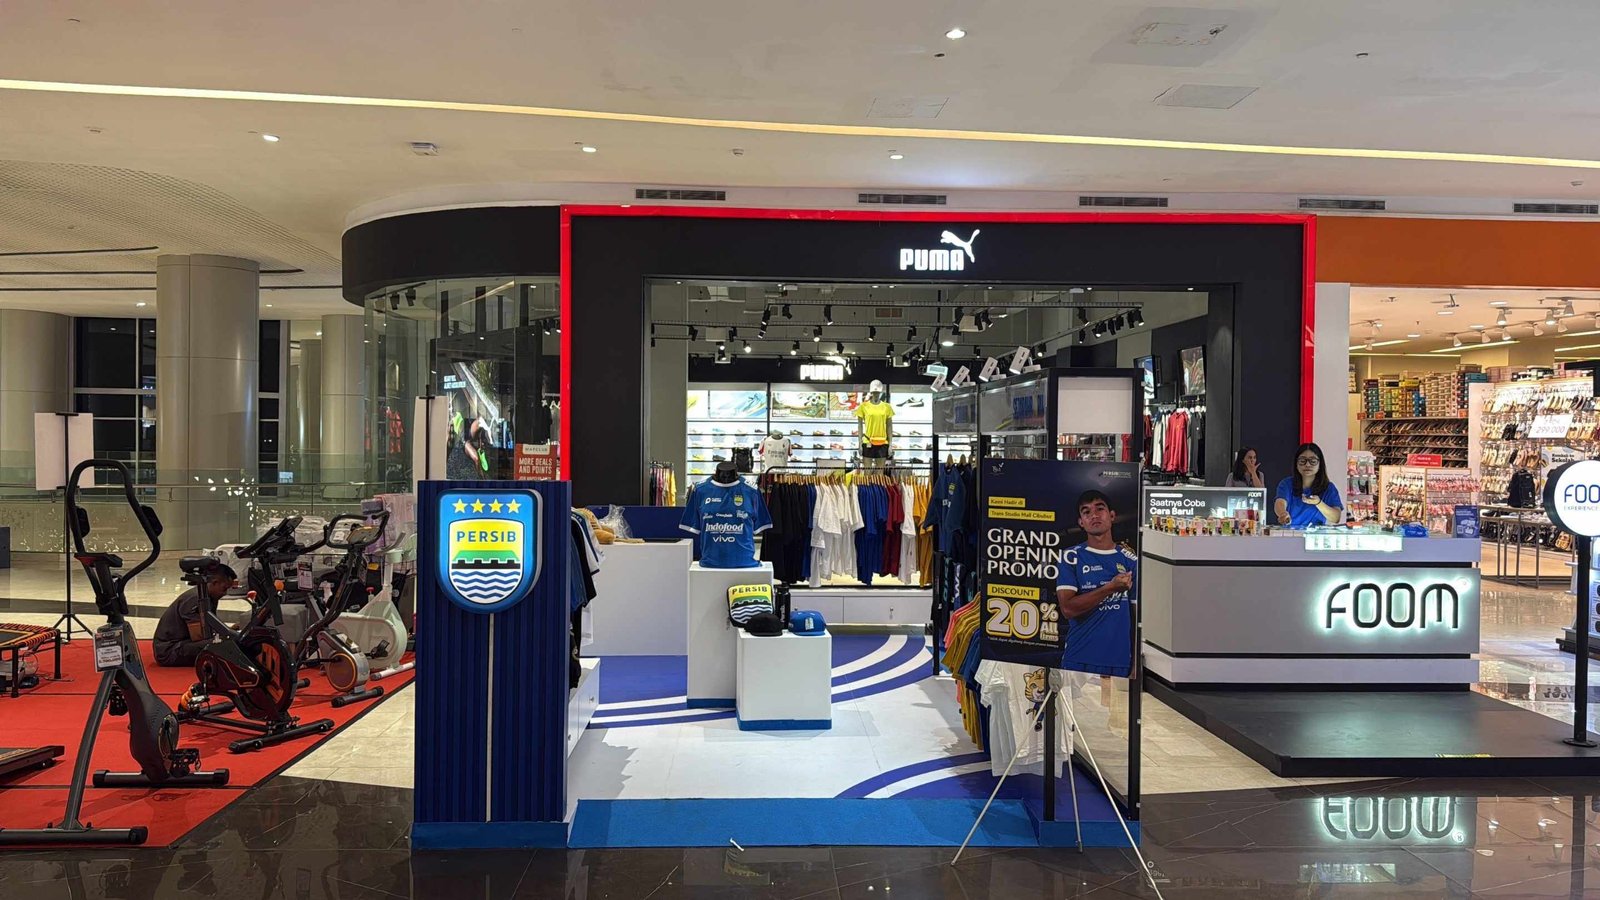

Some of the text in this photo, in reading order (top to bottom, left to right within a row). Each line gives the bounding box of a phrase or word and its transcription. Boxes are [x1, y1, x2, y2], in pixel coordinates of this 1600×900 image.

[900, 248, 964, 271] PUMA
[800, 364, 844, 380] PUMA
[519, 457, 553, 466] MORE DEALS
[519, 465, 553, 475] AND POINTS
[1150, 499, 1205, 507] Saatnya Coba
[1150, 507, 1194, 515] Cara Baru!
[705, 523, 744, 534] Indofood
[456, 531, 516, 542] PERSIB
[712, 534, 736, 543] vivo
[987, 528, 1060, 547] GRAND
[987, 544, 1078, 565] OPENING
[987, 560, 1059, 580] PROMO
[732, 585, 768, 595] PERSIB
[991, 586, 1036, 597] DISCOUNT
[1326, 583, 1458, 628] FOOM
[1040, 621, 1059, 634] All
